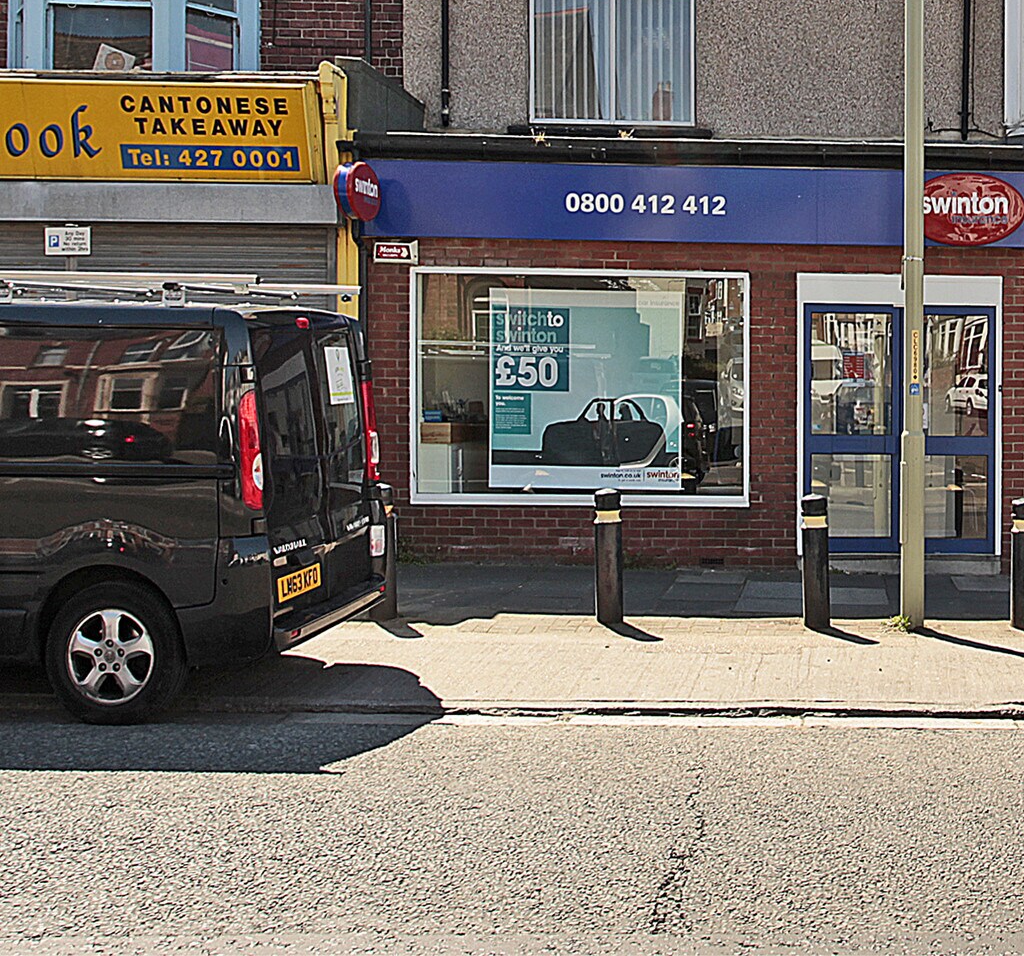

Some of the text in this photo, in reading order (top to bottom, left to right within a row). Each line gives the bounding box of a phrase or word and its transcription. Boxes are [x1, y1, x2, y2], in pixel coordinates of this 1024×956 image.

[120, 95, 289, 115] CANTONESE
[134, 117, 283, 137] TAKEAWAY
[127, 148, 293, 168] Tel: 427 0001
[565, 192, 726, 215] 0800 412 412
[923, 191, 1009, 214] swinton
[532, 345, 548, 354] give
[549, 346, 564, 354] you
[495, 355, 558, 387] £50
[646, 470, 680, 479] swinton
